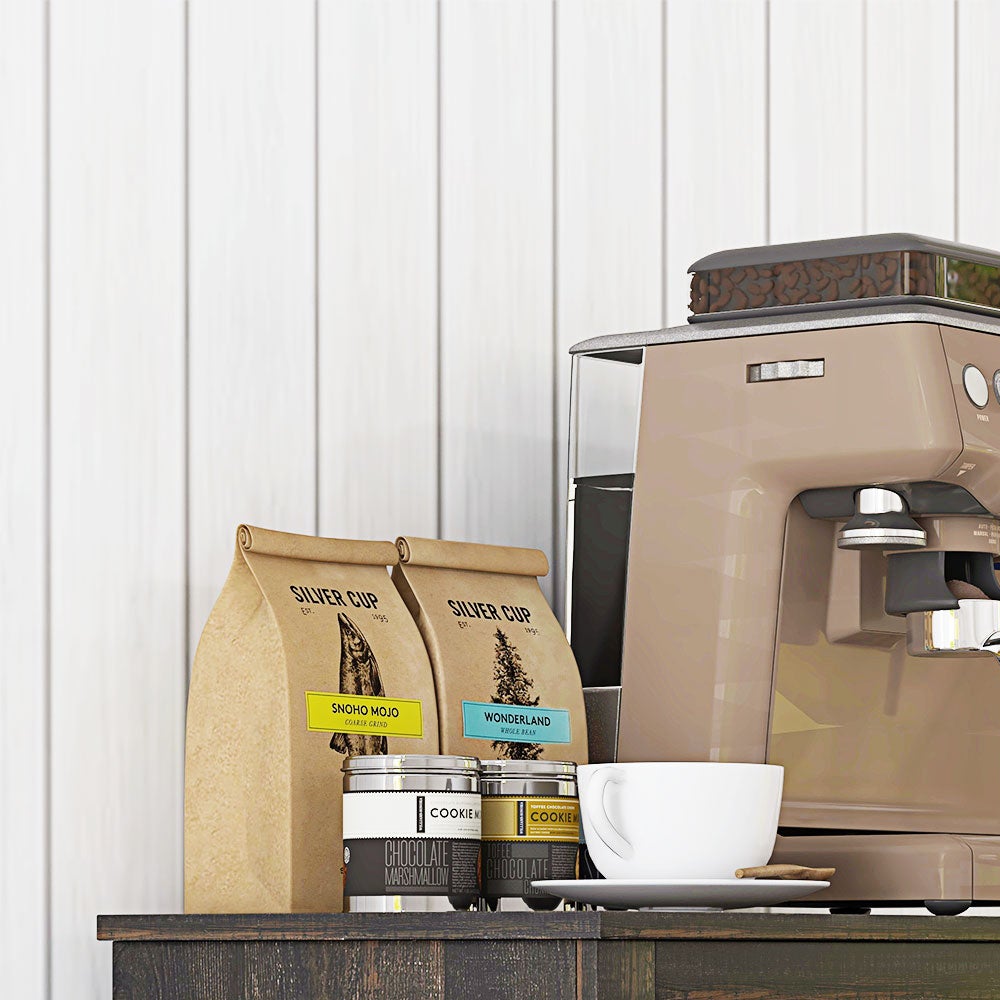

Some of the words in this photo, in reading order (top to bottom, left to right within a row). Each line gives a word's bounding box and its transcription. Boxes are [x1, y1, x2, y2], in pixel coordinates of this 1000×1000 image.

[290, 586, 347, 606] SILVER
[346, 590, 378, 609] CUP
[448, 600, 502, 620] SILVER
[500, 605, 531, 623] CUP
[332, 703, 368, 716] SNOHO
[370, 706, 399, 718] MOJO
[369, 720, 388, 728] GRIND
[484, 712, 551, 726] WONDERLAND
[500, 727, 520, 735] WHOLE
[430, 808, 473, 819] COOKIE
[531, 812, 572, 822] COOKIE
[385, 840, 449, 866] CHOCOLATE
[385, 867, 449, 886] MARSHMALLOW
[486, 859, 548, 879] CHOCOLATE
